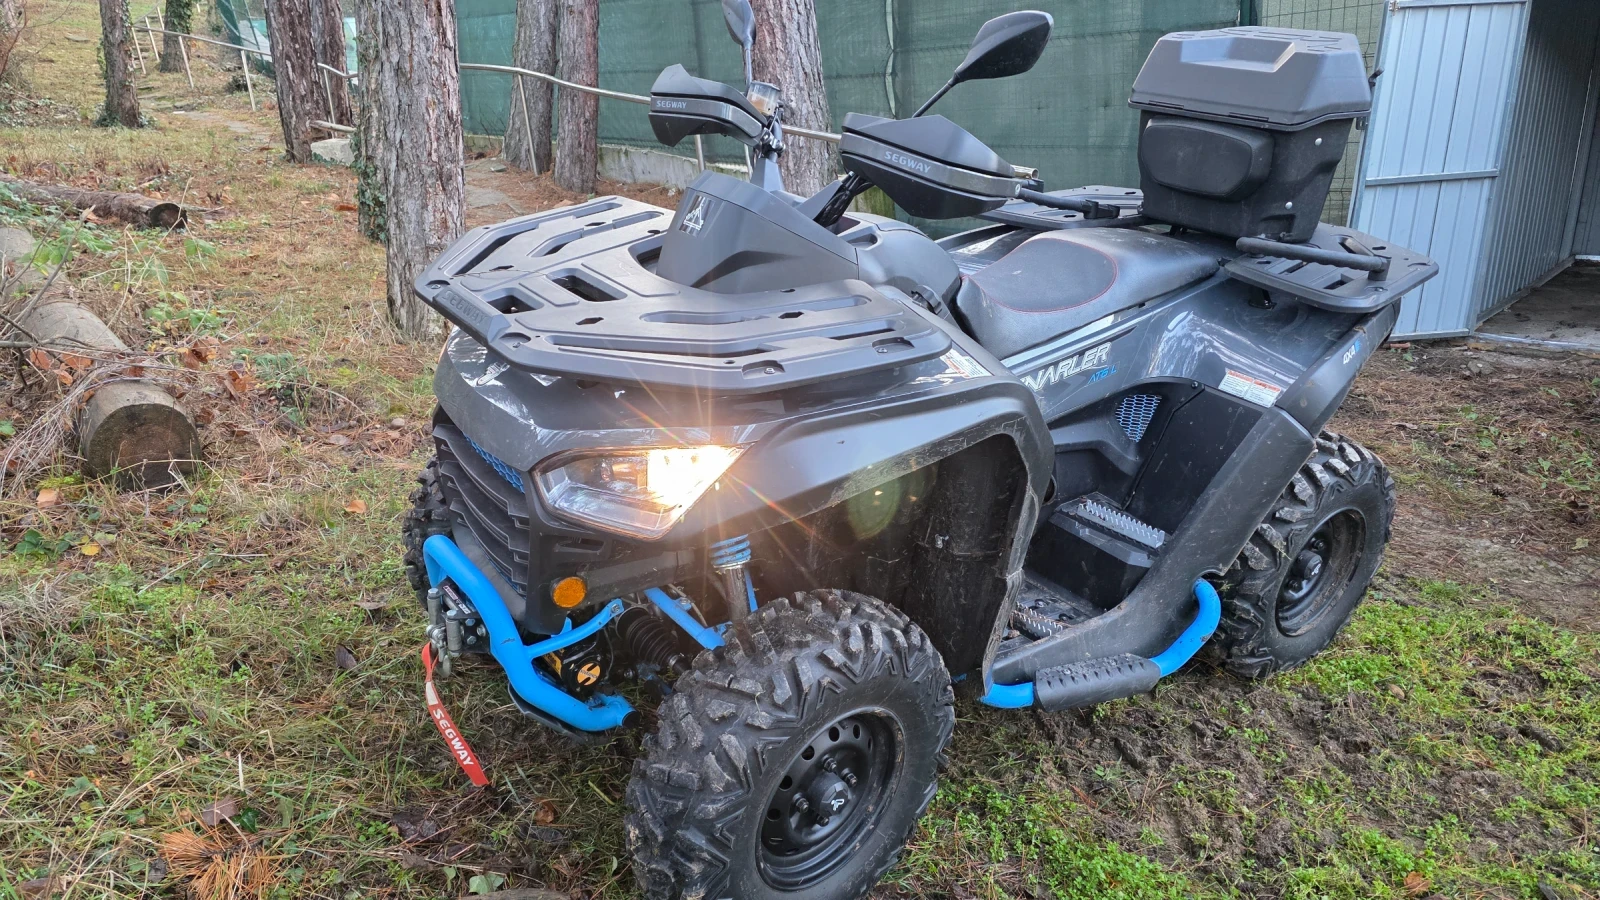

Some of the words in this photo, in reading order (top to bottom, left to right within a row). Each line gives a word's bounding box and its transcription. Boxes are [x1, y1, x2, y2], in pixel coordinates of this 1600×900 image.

[656, 100, 687, 109] SEGWAY
[884, 151, 931, 173] SEGWAY
[442, 290, 489, 325] SEGWAY
[1020, 341, 1112, 392] NARLER
[433, 708, 474, 765] SEGWAY
